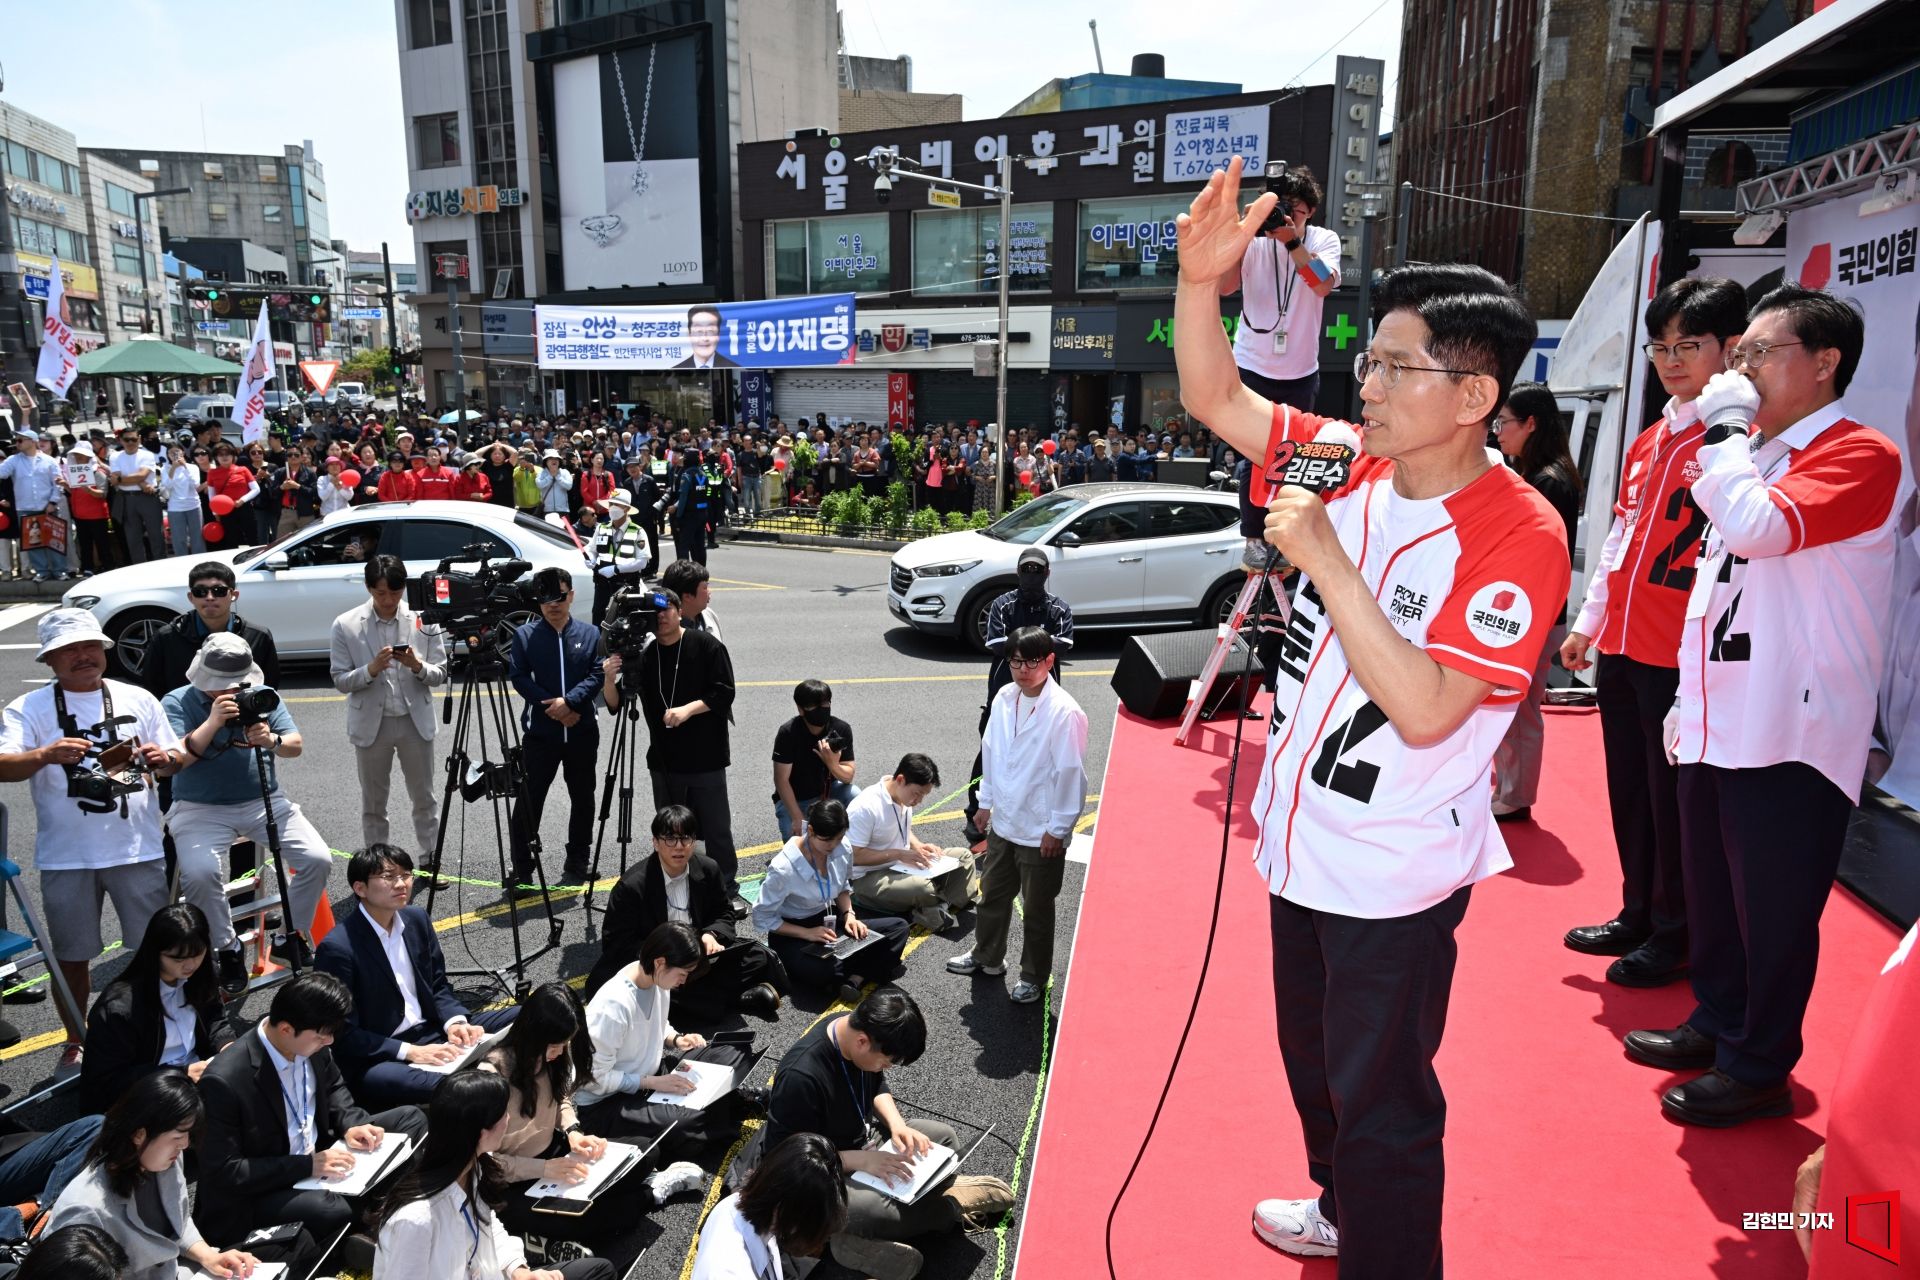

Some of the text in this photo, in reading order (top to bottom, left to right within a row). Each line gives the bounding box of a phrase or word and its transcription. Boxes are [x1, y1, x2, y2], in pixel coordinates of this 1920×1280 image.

[1175, 115, 1230, 136] 진료과목
[1174, 134, 1258, 157] 소아청소년과
[1173, 156, 1260, 177] T.676-975
[426, 186, 520, 216] 지성치과 의원
[837, 233, 862, 255] 서울
[1091, 221, 1178, 262] 이비인후
[664, 261, 698, 273] LLOYD
[824, 256, 877, 278] 이비인후과
[1838, 227, 1918, 286] 국민의힘
[543, 322, 567, 339] 잠실
[582, 316, 617, 339] 안성
[631, 321, 682, 338] 청주공항
[758, 315, 849, 352] 이재명
[1054, 317, 1076, 332] 서울
[726, 319, 739, 356] 1
[1053, 335, 1107, 349] 이비인후과
[545, 344, 682, 360] 광역급행철도 민간투자사업 지원
[747, 397, 759, 419] 병의
[1266, 442, 1295, 481] 2
[1283, 457, 1344, 488] 김문수
[78, 474, 88, 484] 2
[1648, 487, 1711, 592] 2
[1472, 609, 1521, 636] 국민의힘
